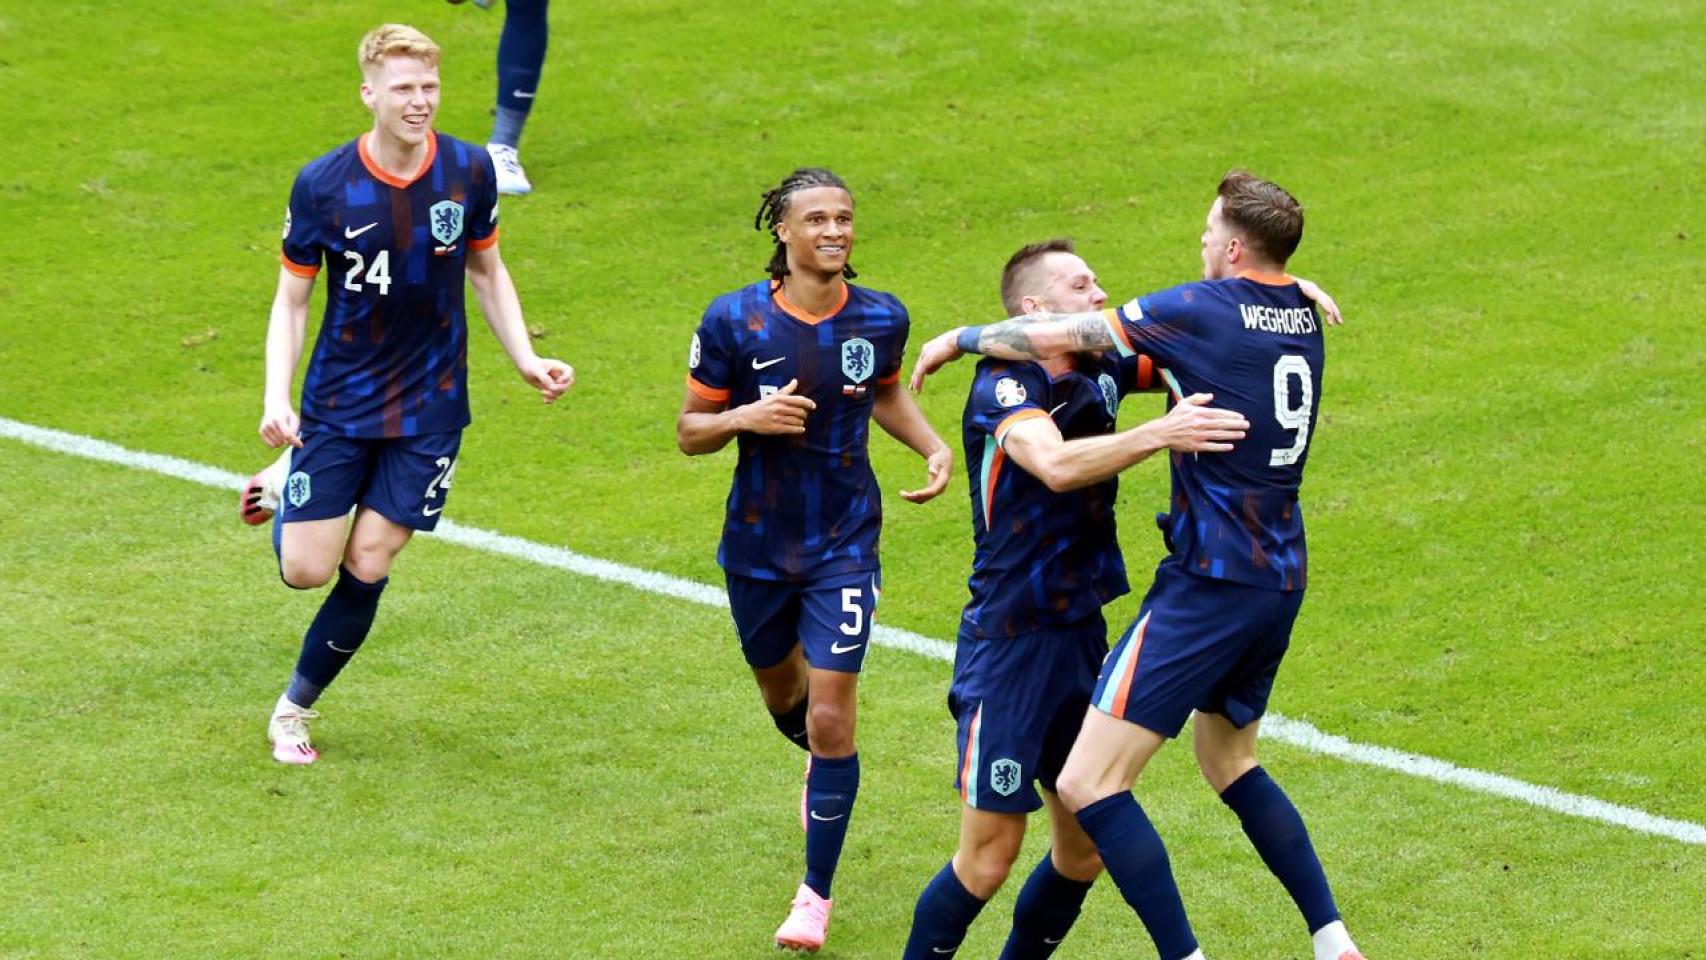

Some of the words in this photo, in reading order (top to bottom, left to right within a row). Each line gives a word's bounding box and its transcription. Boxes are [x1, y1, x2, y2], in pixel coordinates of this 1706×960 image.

[344, 250, 392, 295] 24
[1269, 355, 1313, 466] 9
[839, 588, 863, 636] 5
